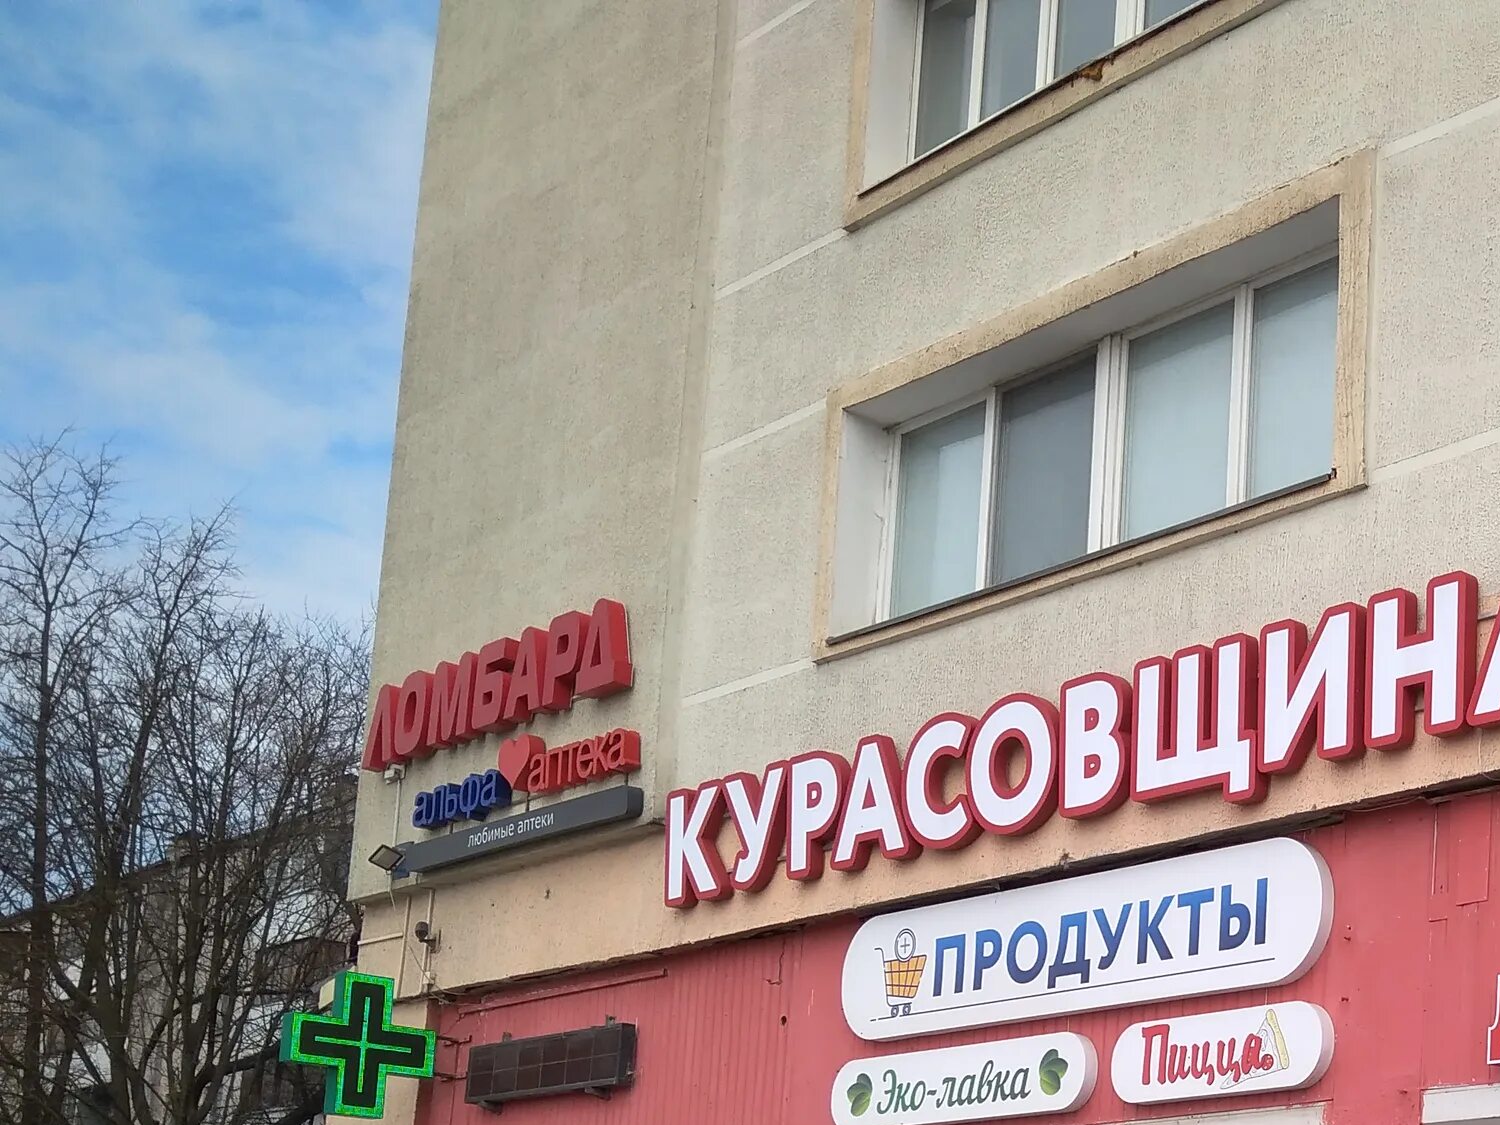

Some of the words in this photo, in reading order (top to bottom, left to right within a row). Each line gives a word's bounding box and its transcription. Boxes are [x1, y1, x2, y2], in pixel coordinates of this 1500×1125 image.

[361, 597, 633, 772] ЛОМБАРД
[411, 767, 512, 830] альфа
[526, 727, 642, 794] аптека
[467, 823, 515, 849] любимые
[517, 810, 555, 838] аптеки
[932, 877, 1269, 996] ПРОДУКТЫ
[875, 1061, 1032, 1117] Эко-лавка
[1140, 1023, 1267, 1087] Пицца
